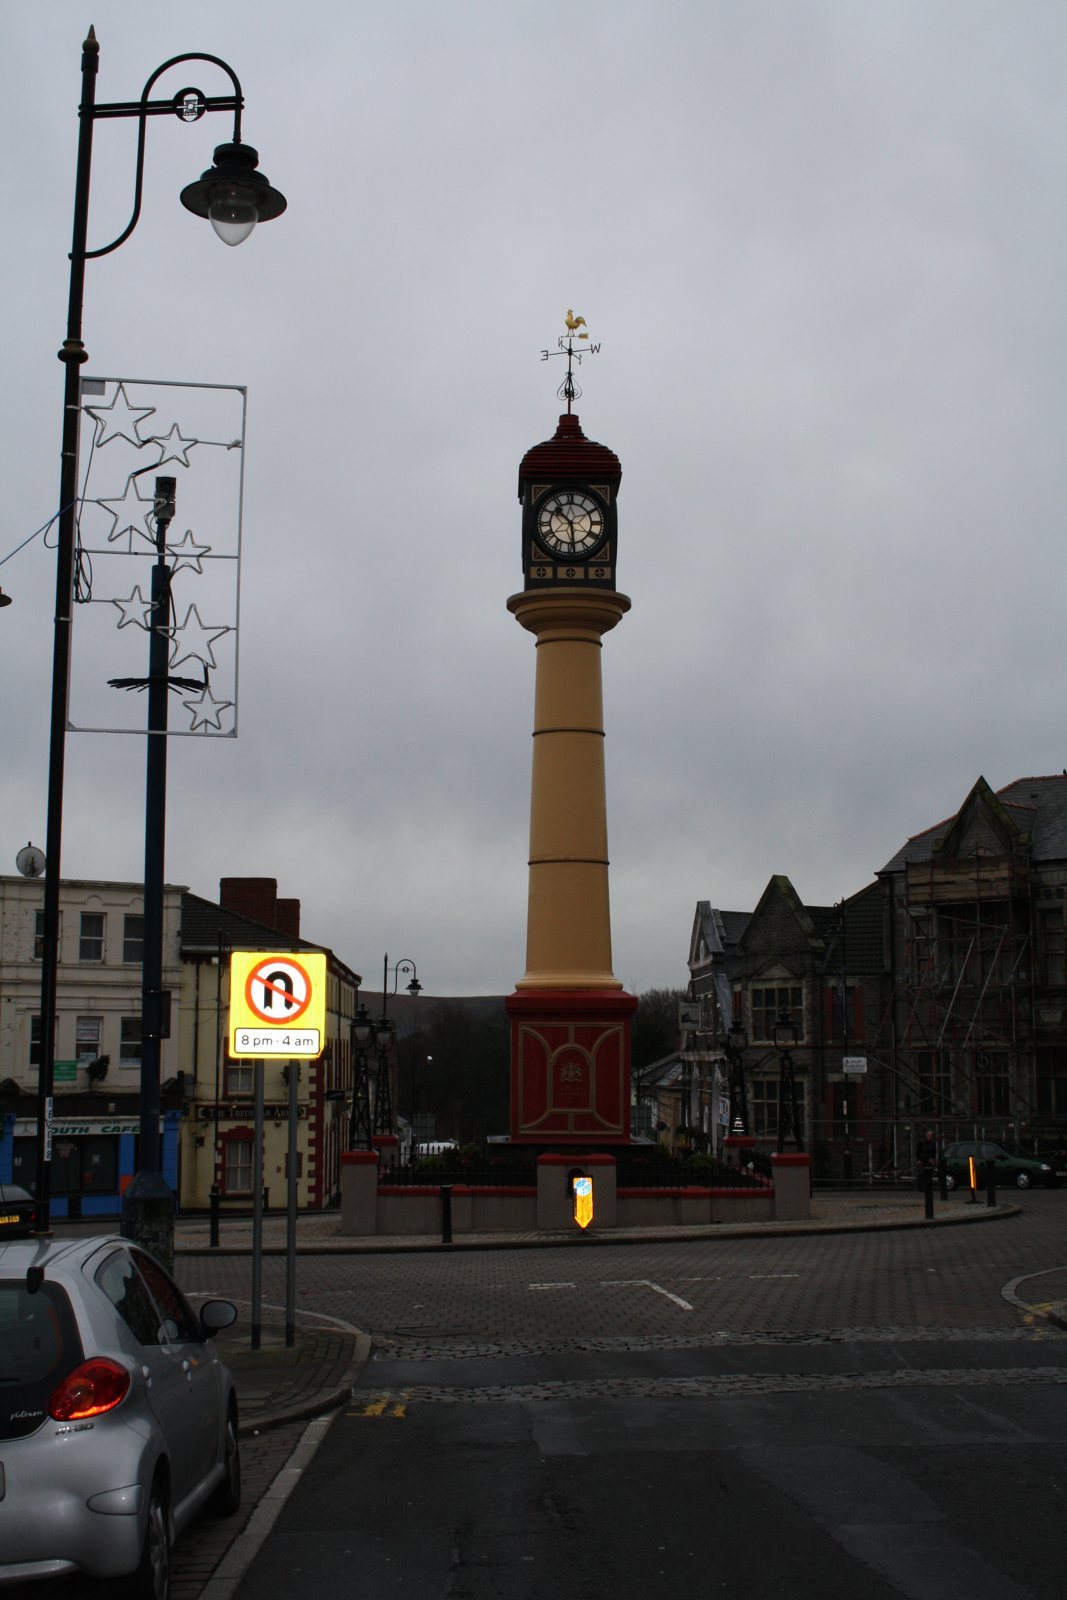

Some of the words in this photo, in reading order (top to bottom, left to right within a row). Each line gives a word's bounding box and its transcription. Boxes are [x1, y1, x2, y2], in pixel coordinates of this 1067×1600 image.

[241, 1034, 249, 1046] 8
[253, 1037, 273, 1047] pm
[282, 1035, 291, 1046] 4
[294, 1038, 314, 1046] am
[10, 1409, 43, 1421] platinum
